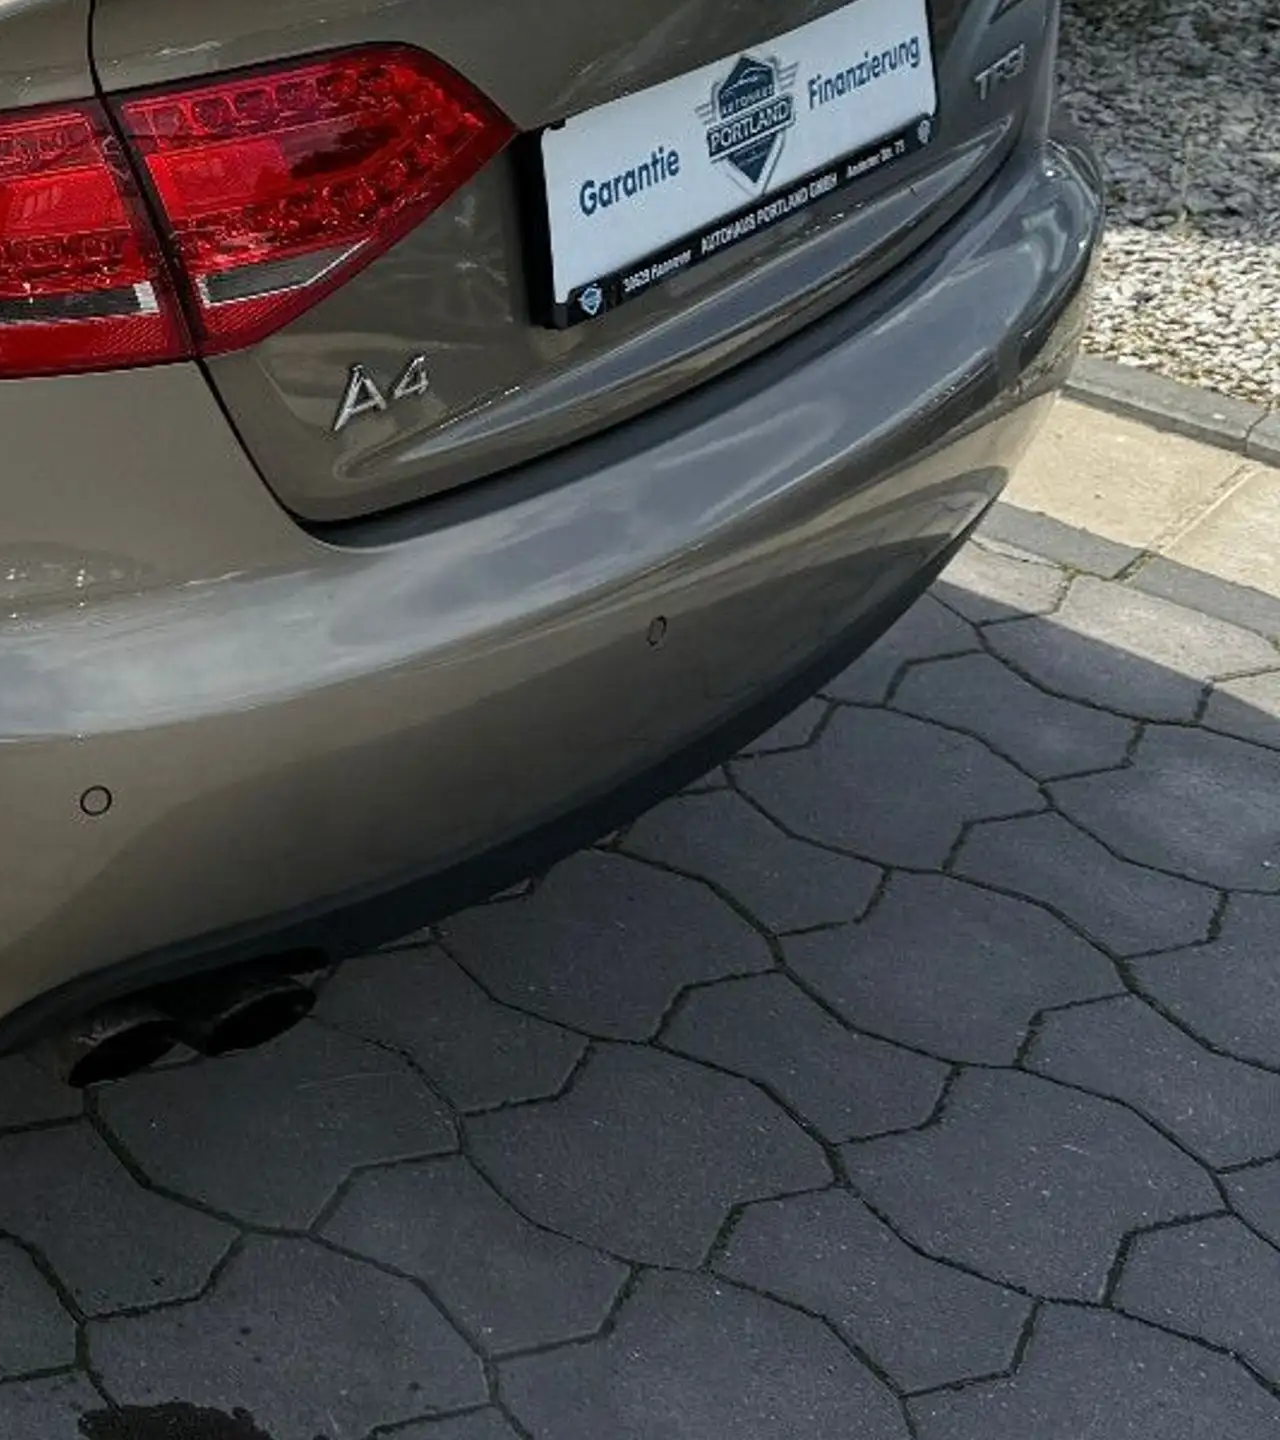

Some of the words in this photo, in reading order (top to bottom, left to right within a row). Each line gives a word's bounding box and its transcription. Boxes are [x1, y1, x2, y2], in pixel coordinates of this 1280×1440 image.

[807, 36, 921, 110] Finanzierung
[709, 101, 789, 153] PORTLAND
[579, 146, 680, 216] Garantie
[757, 187, 809, 224] PORTLAND
[334, 356, 429, 431] A4
